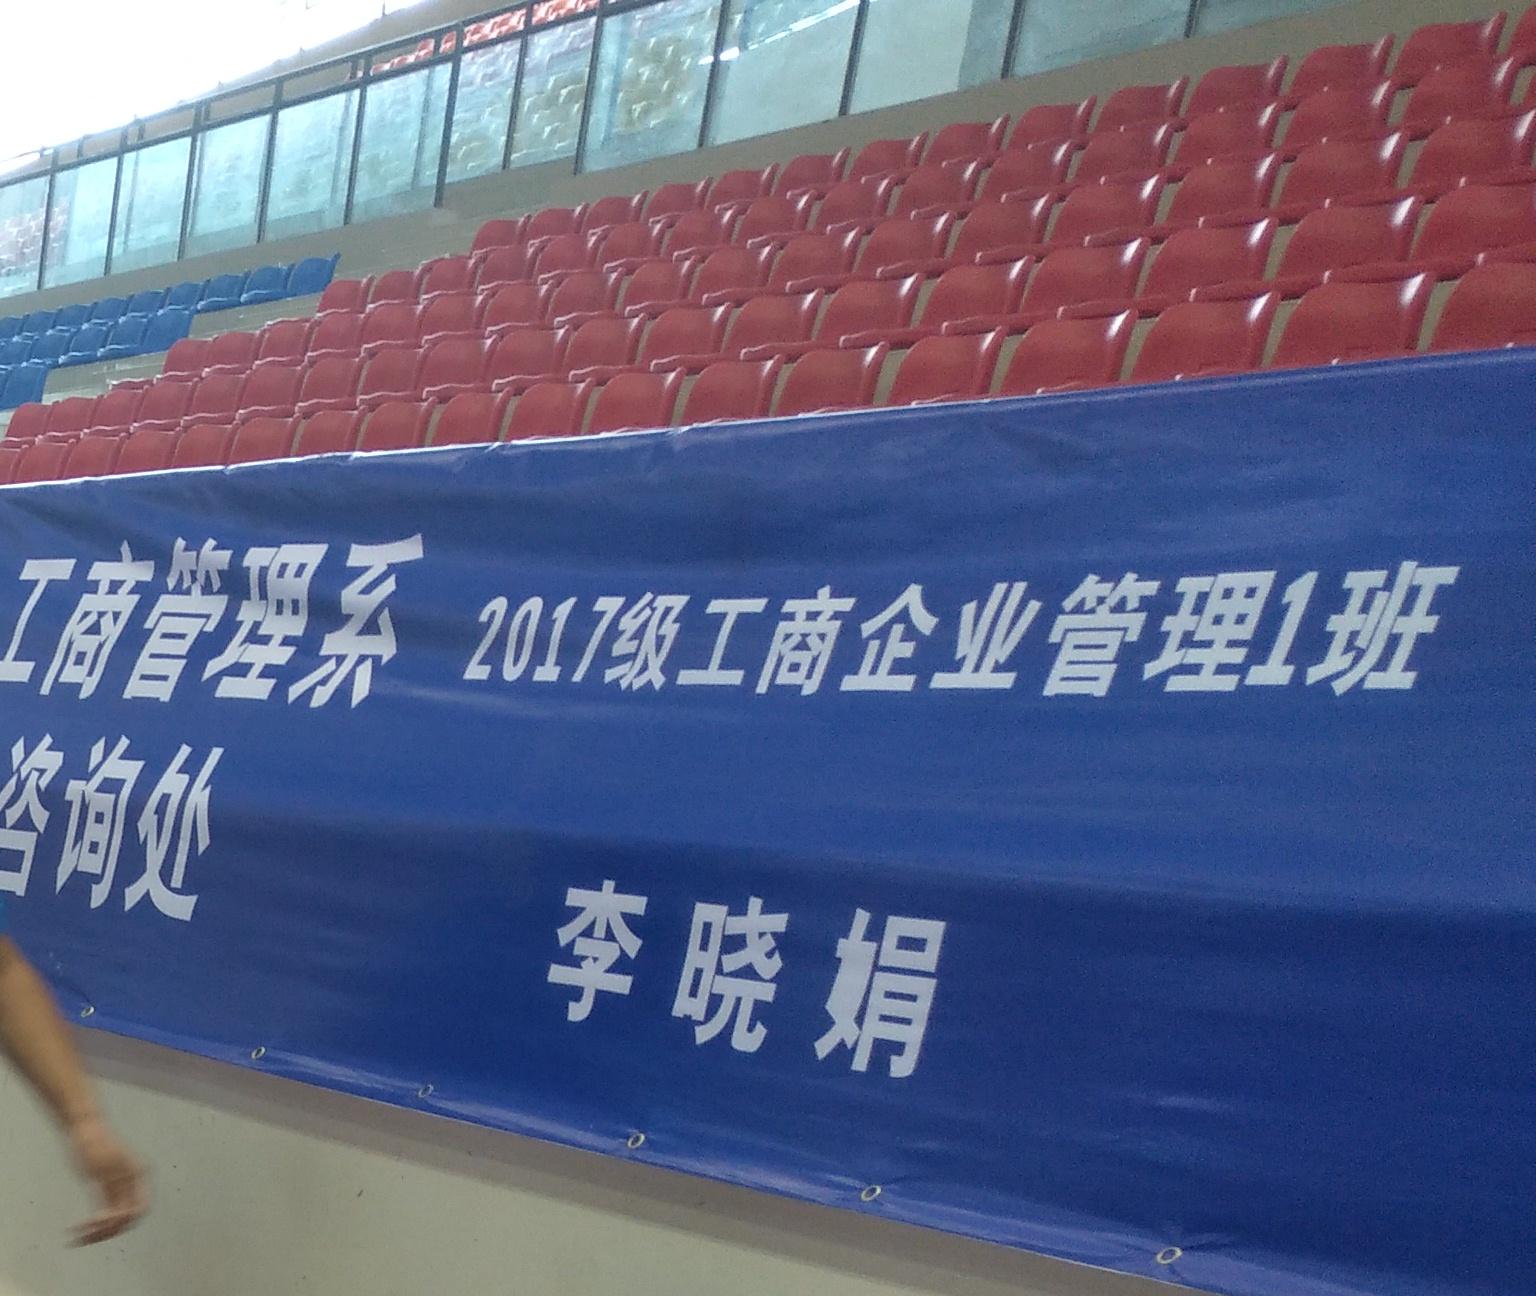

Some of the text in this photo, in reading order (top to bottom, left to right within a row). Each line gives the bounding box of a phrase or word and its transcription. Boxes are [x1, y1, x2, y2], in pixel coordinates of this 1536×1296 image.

[464, 561, 1461, 697] 2017级工商企业管理1班
[549, 879, 948, 1079] 李晓娟
